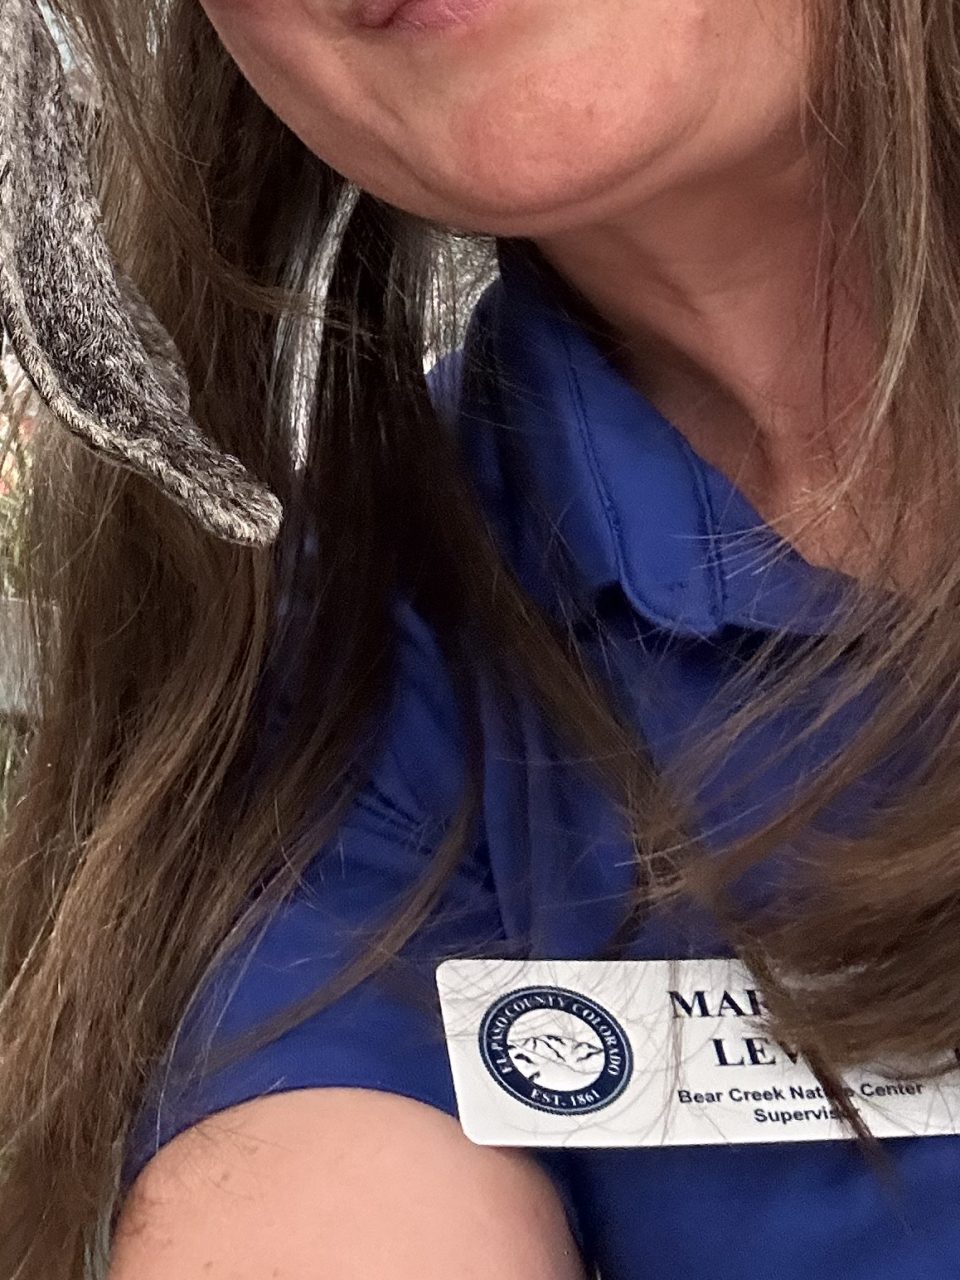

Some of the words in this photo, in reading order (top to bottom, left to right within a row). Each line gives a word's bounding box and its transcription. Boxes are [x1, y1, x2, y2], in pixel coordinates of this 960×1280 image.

[504, 994, 567, 1019] COUNTY
[571, 1001, 623, 1077] COLORADO
[530, 1087, 567, 1107] EST.
[569, 1088, 601, 1107] 1861
[677, 1088, 724, 1104] Bear
[728, 1085, 786, 1102] Creek
[859, 1081, 924, 1097] Center
